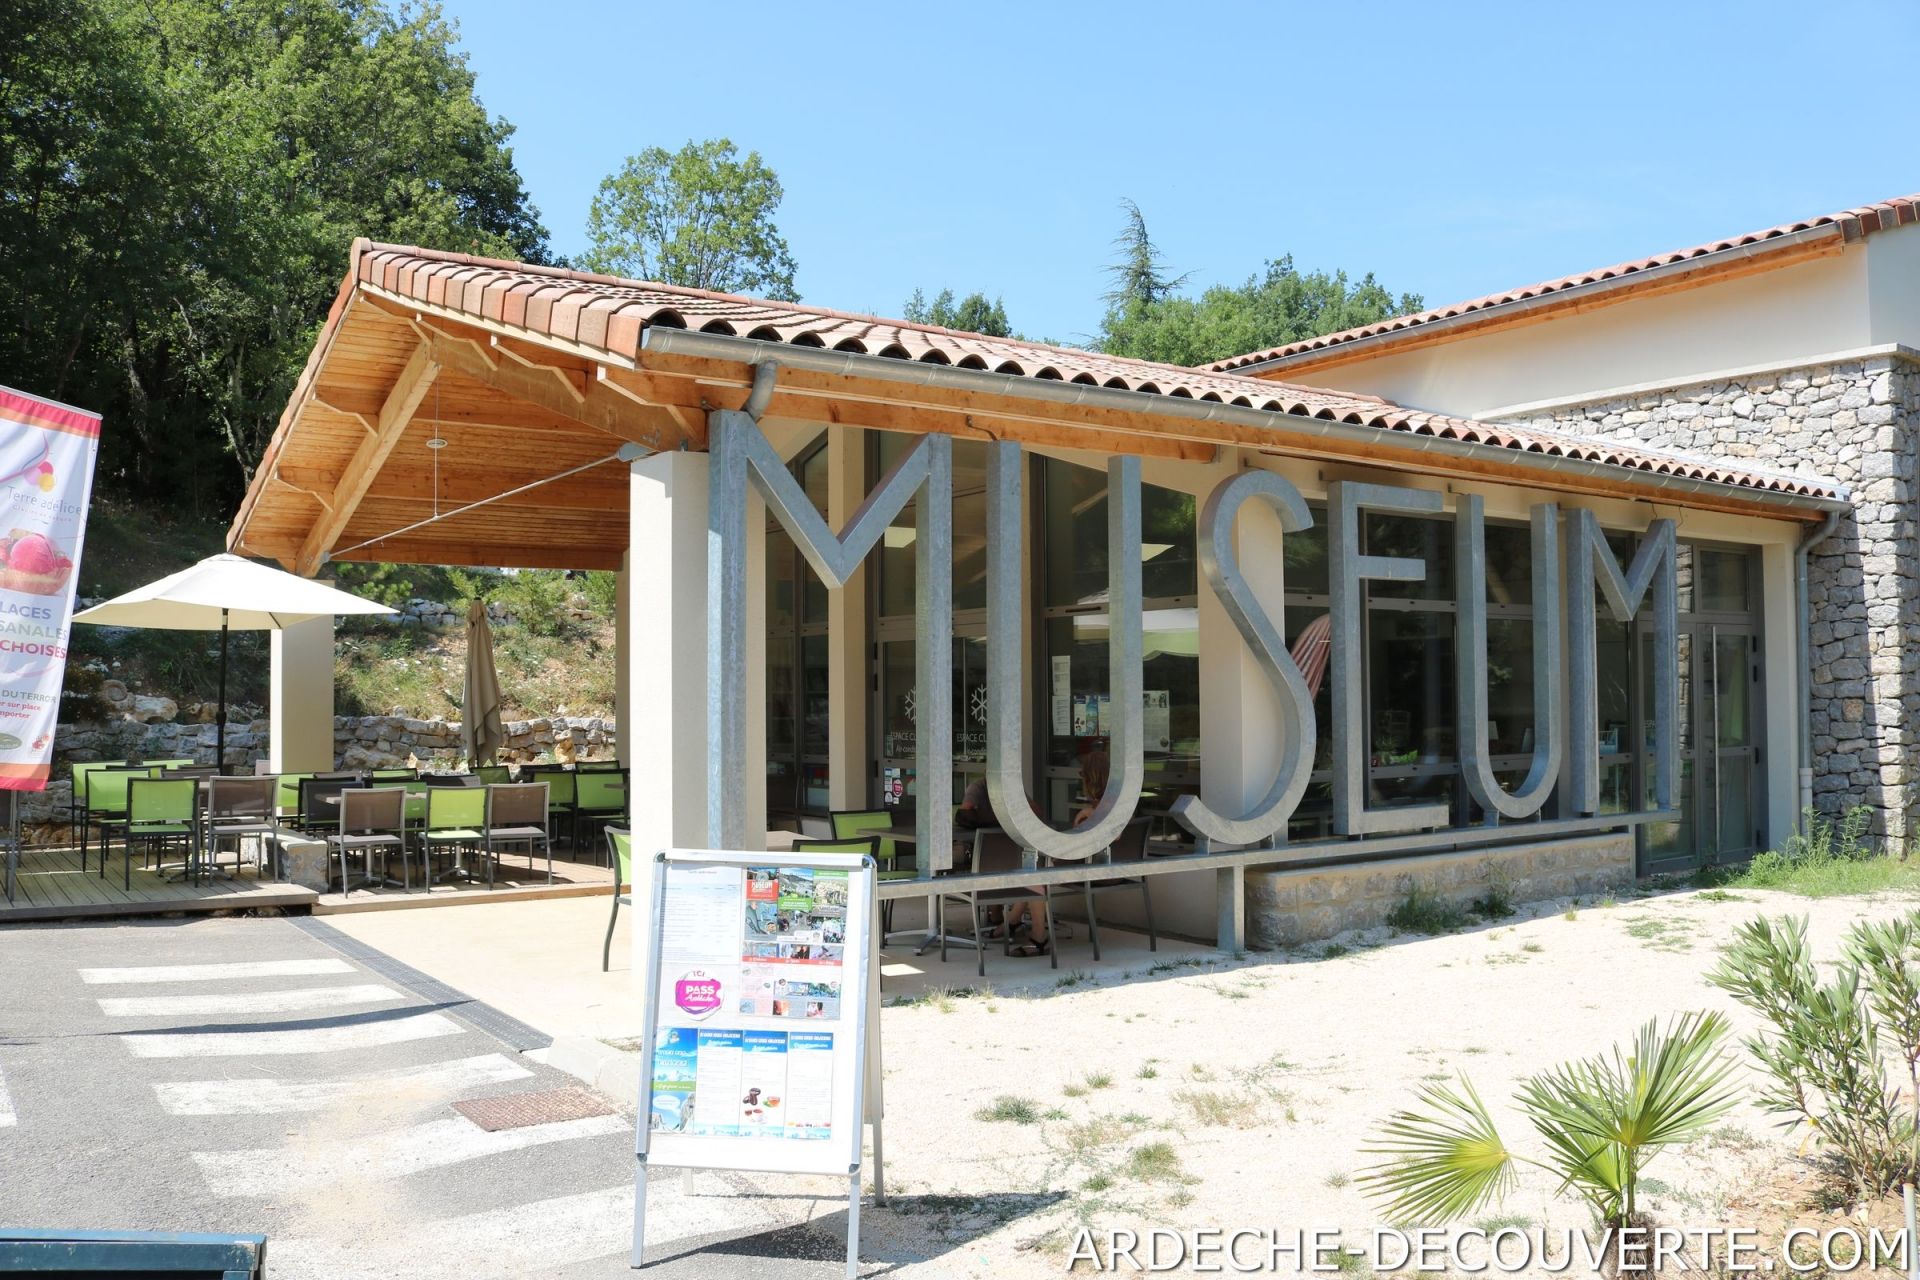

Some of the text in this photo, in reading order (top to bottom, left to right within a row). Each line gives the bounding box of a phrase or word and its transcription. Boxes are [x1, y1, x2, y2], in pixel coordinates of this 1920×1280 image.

[8, 486, 37, 504] Terre
[0, 601, 52, 619] LACES
[0, 620, 67, 640] SANALES
[708, 409, 1680, 871] MUSEUM
[0, 640, 66, 659] CHOISES
[2, 689, 18, 699] DU
[0, 710, 31, 719] mporter
[22, 702, 41, 712] place
[686, 985, 714, 995] PASS
